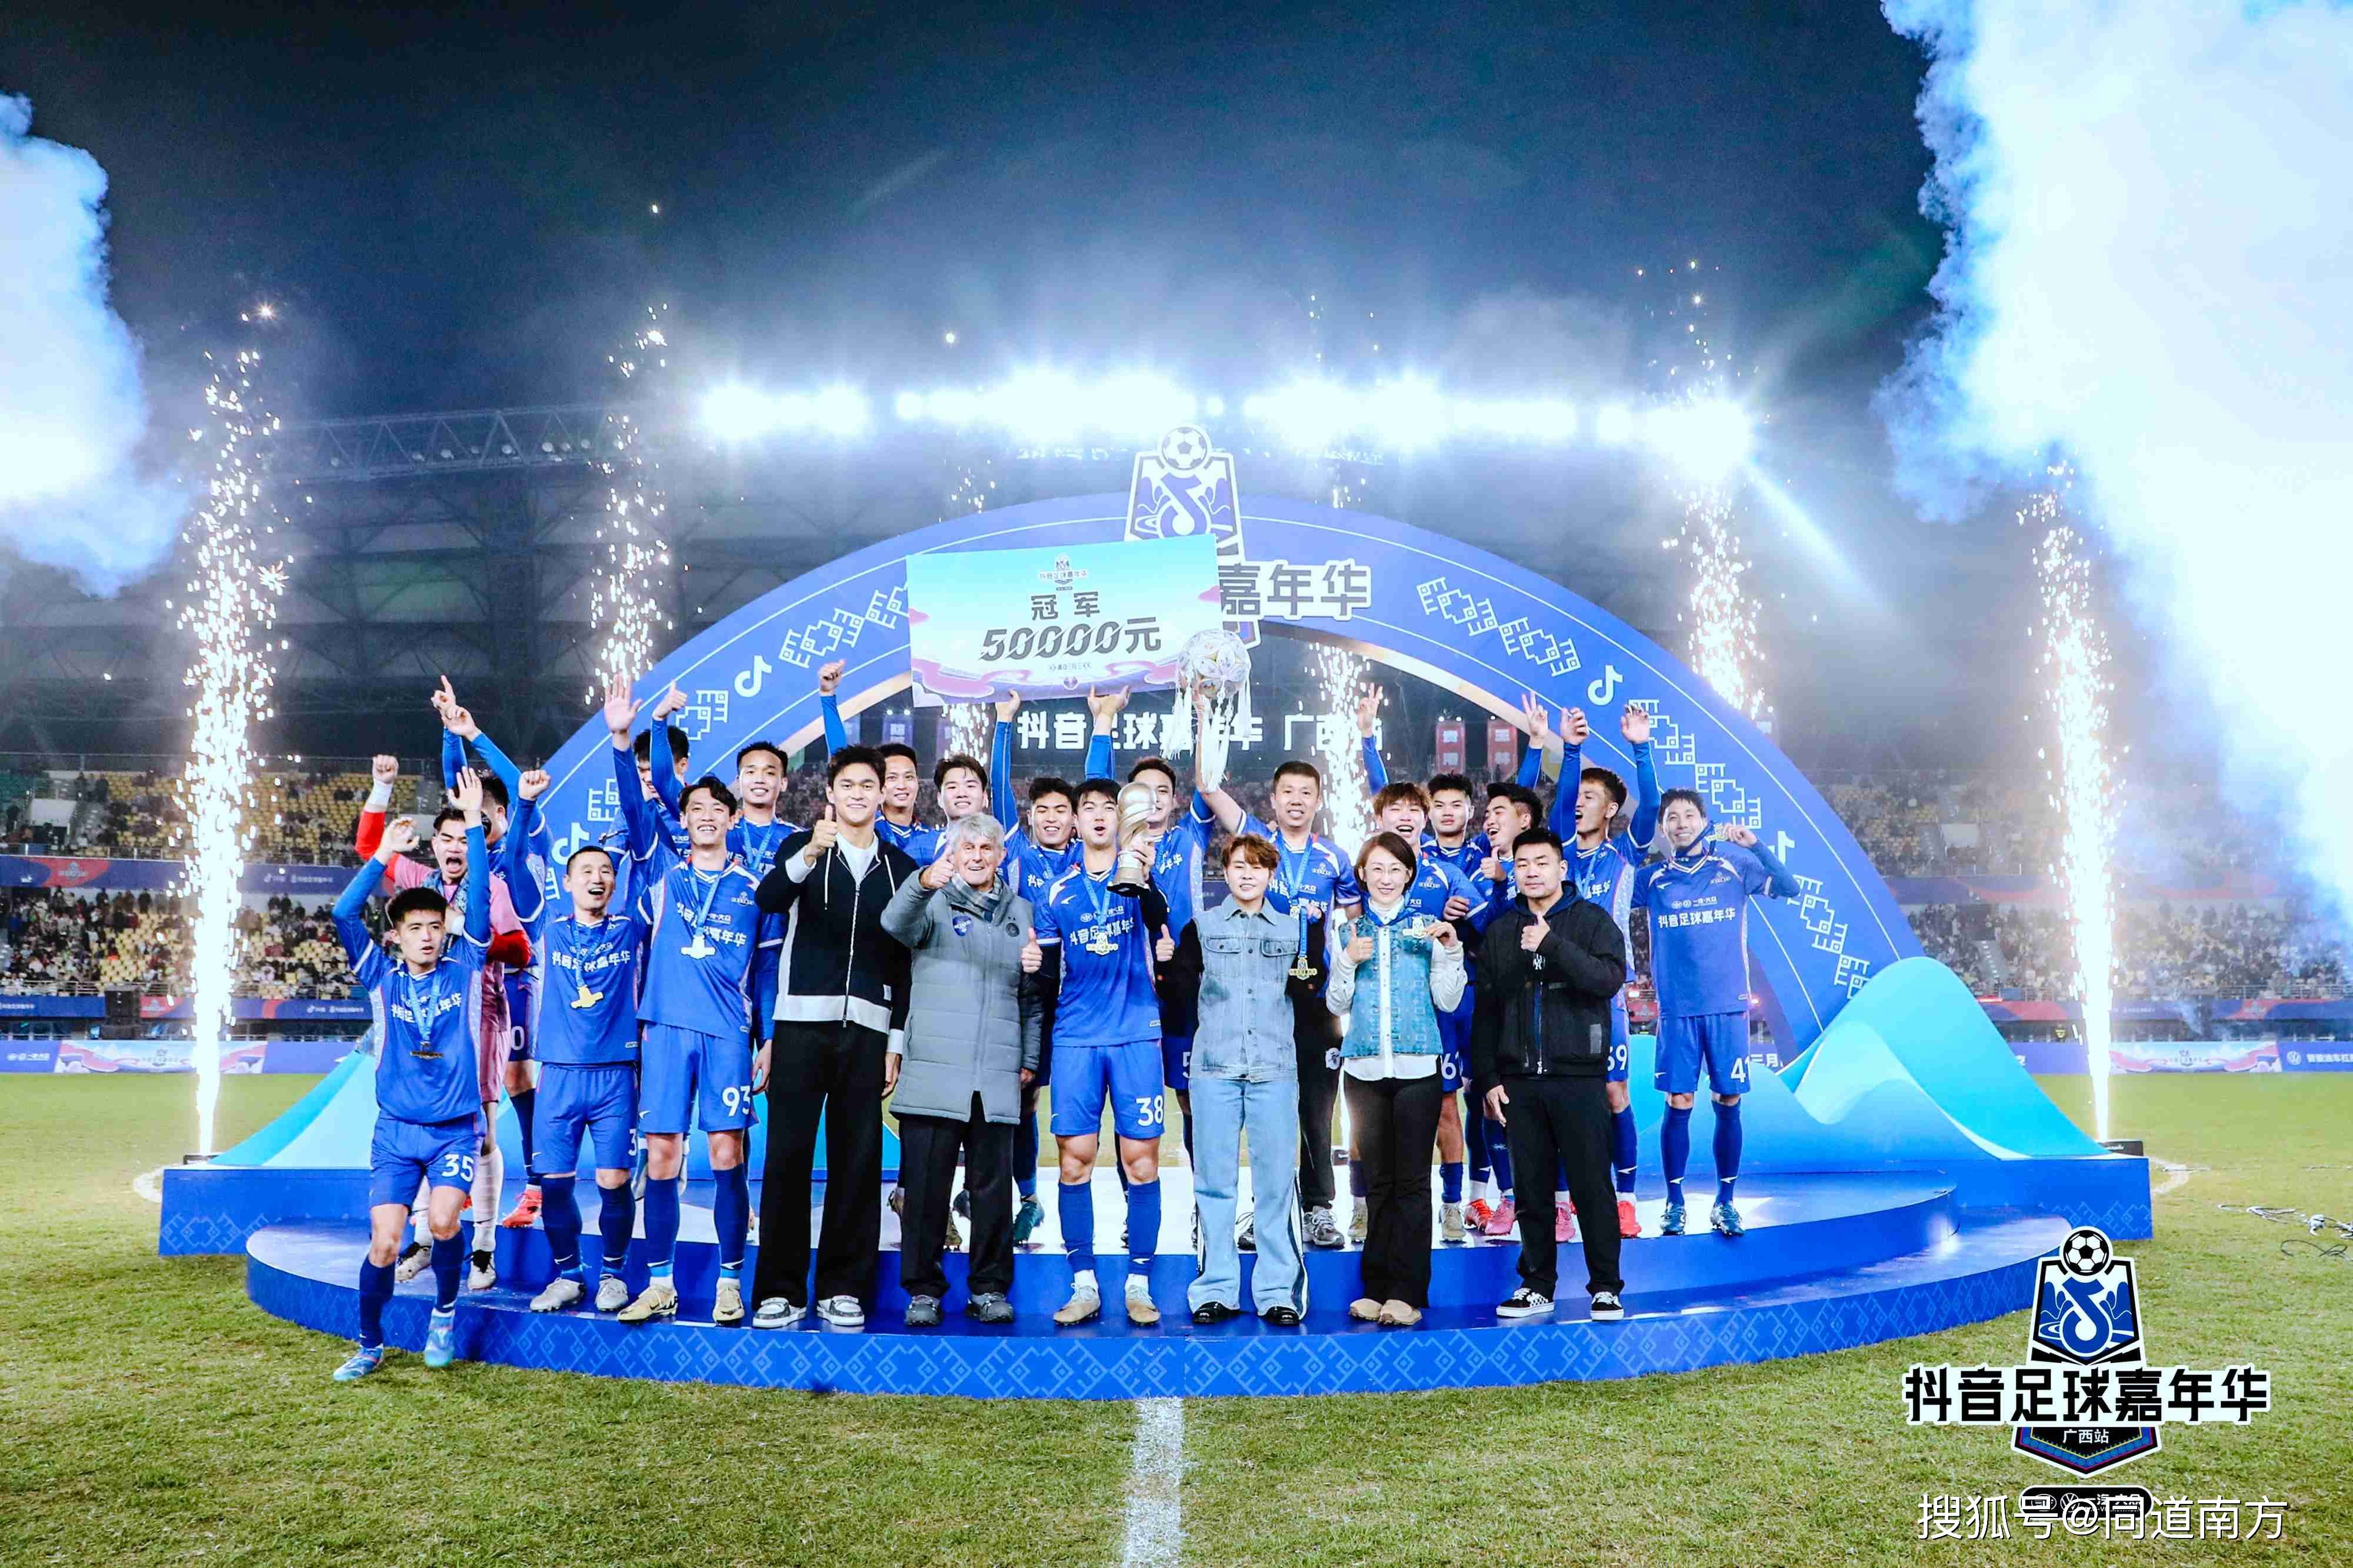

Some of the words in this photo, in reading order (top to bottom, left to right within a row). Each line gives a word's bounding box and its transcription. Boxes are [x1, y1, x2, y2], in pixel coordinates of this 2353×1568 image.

[1218, 563, 1368, 616] 嘉年华
[1031, 591, 1100, 620] 冠军
[978, 616, 1161, 662] 50000元
[1017, 710, 1262, 751] 抖音球华
[1658, 908, 1735, 929] 抖音足球嘉年华
[722, 1085, 751, 1116] 93
[1136, 1095, 1164, 1126] 38
[442, 1154, 475, 1182] 35
